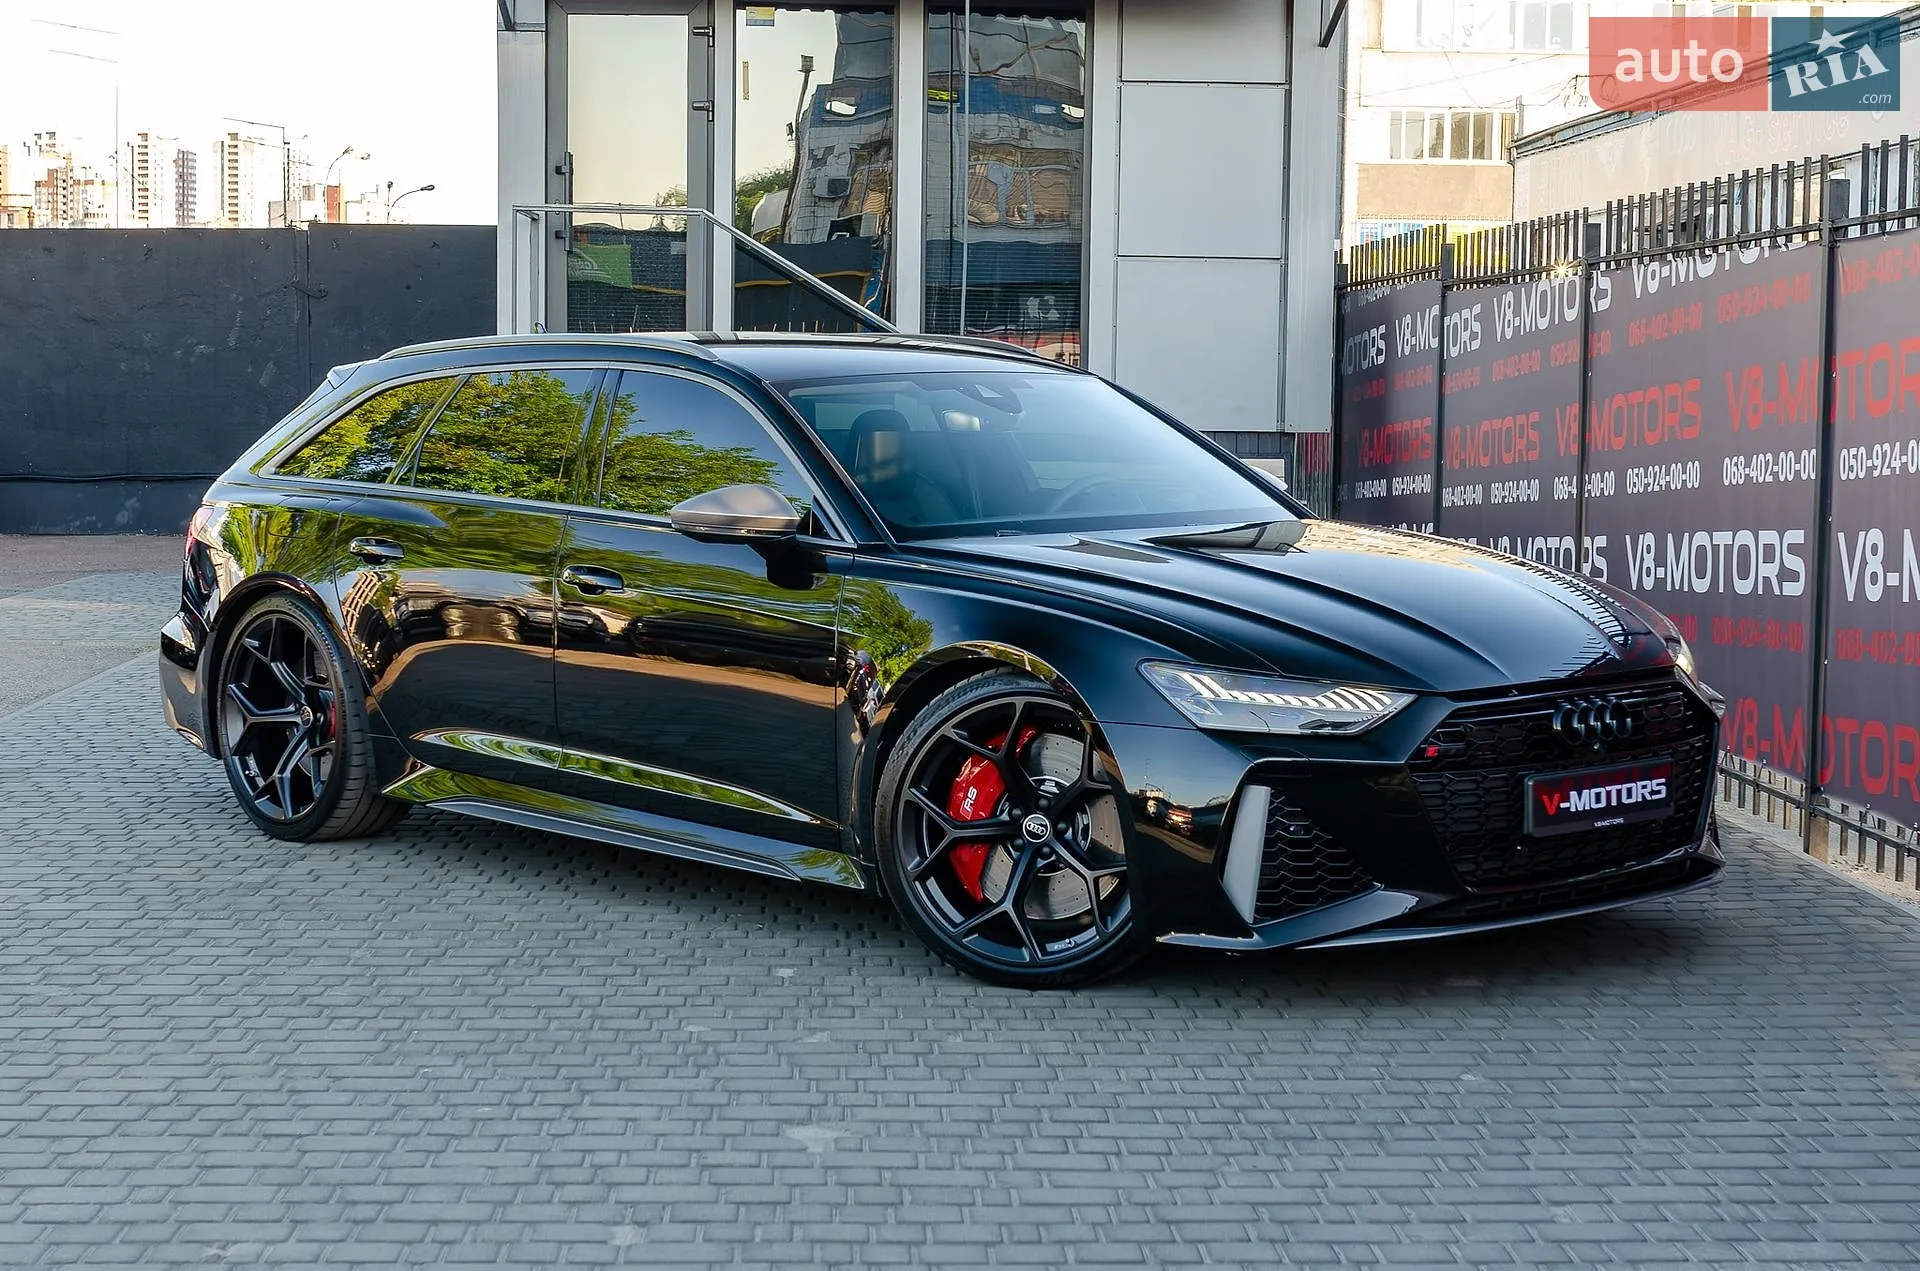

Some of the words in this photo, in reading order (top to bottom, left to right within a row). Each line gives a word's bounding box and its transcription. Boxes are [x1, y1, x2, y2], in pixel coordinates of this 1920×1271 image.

[1490, 478, 1540, 504] 050-924-00-00
[1626, 460, 1701, 494] 050-924-00-00
[1722, 448, 1816, 486] 068-402-00-00
[1625, 529, 1806, 596] V8-MOTORS
[1542, 778, 1667, 816] V-MOTORS
